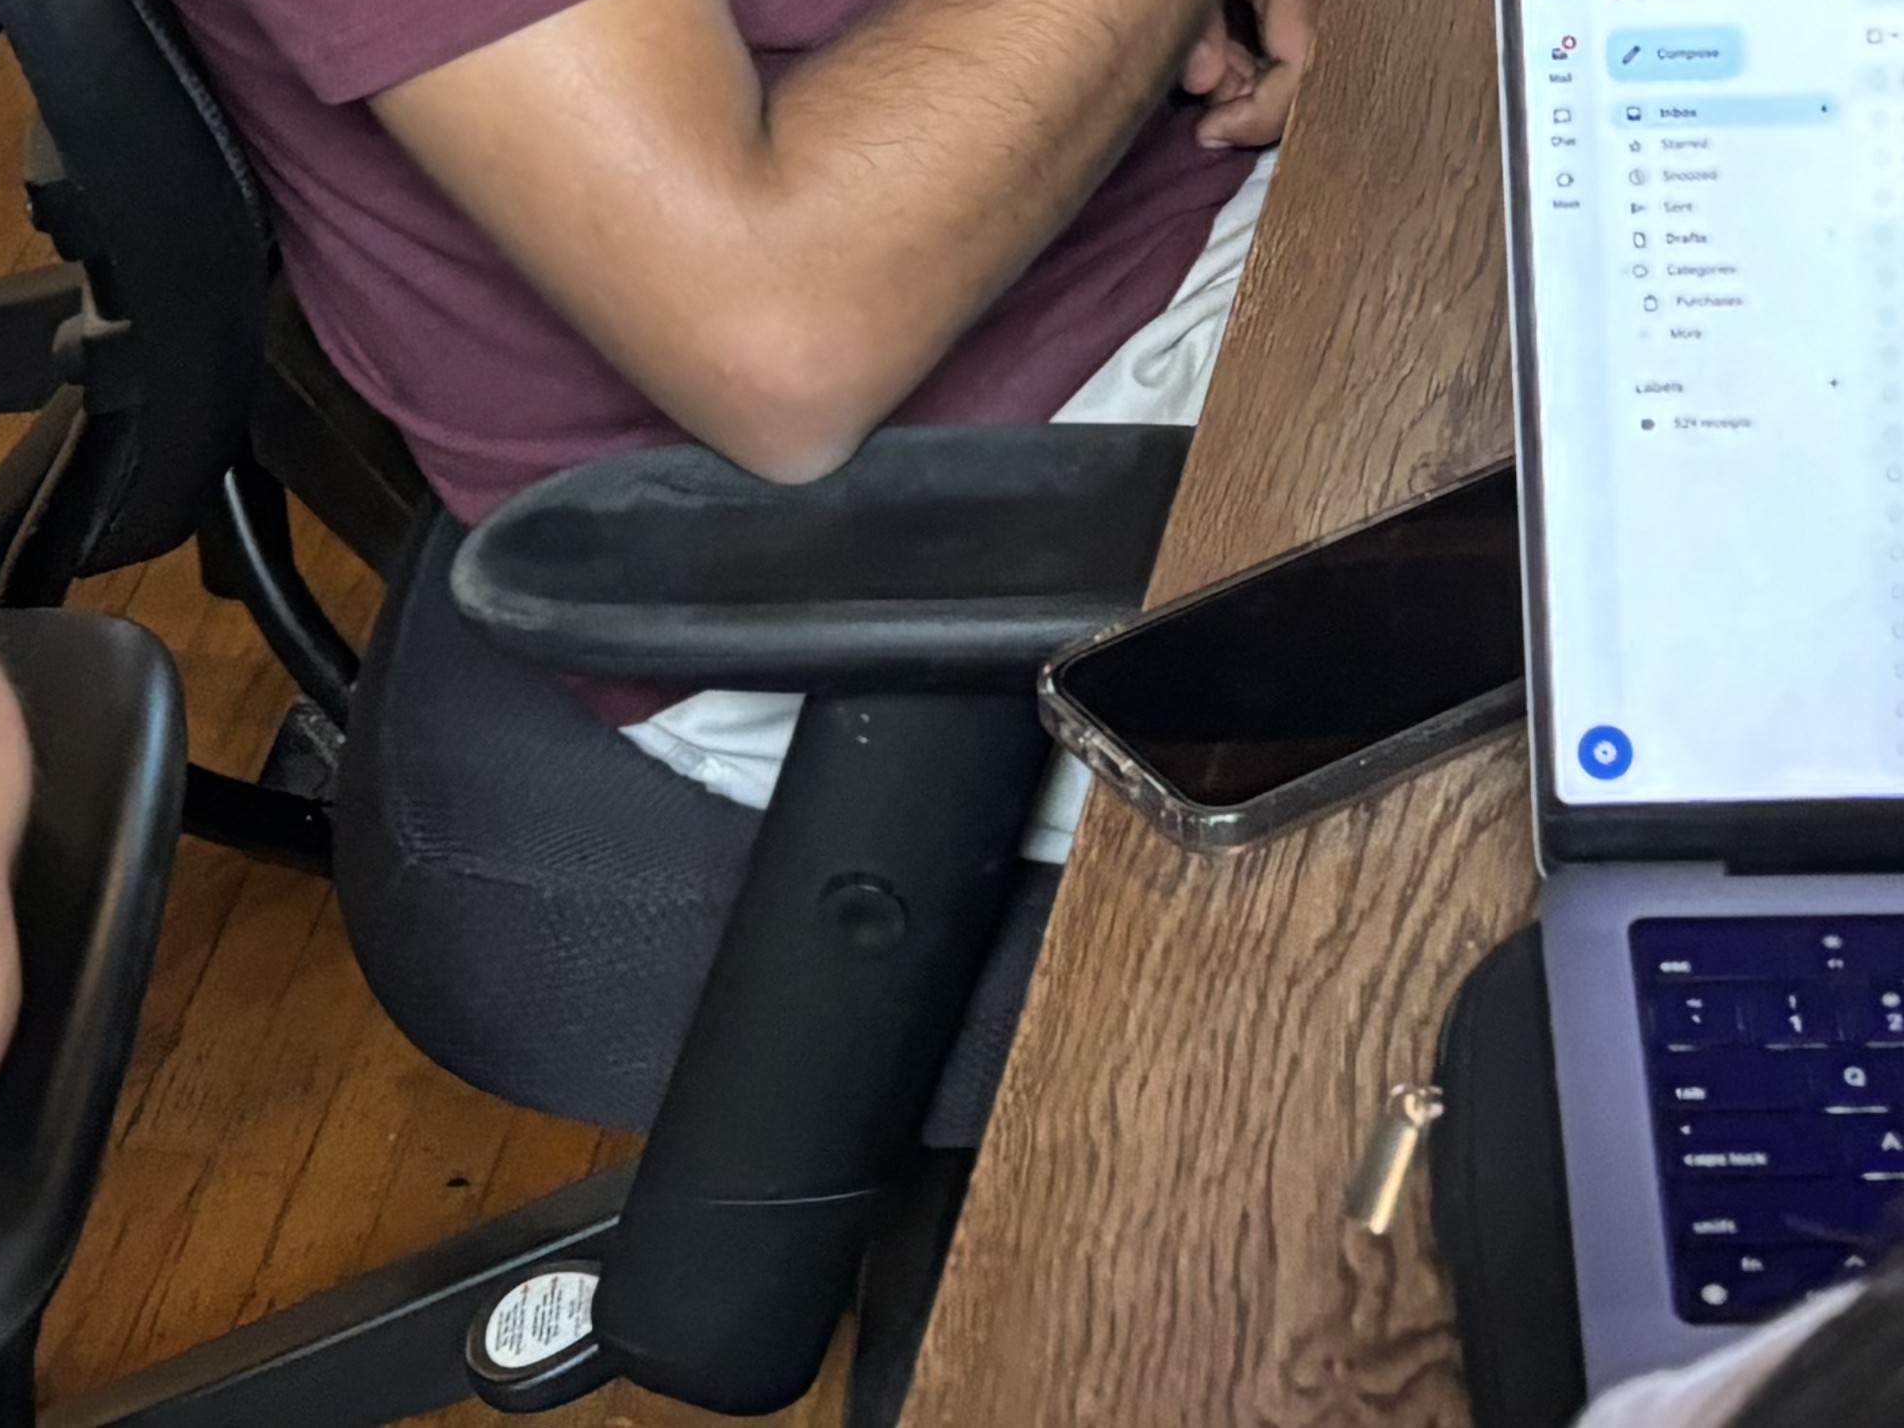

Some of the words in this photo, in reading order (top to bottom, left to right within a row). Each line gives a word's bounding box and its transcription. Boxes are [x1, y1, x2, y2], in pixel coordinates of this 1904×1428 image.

[1656, 47, 1721, 61] Compose
[1659, 106, 1698, 119] Inbox
[1665, 232, 1707, 245] Drafts
[1667, 263, 1736, 277] Categories
[1843, 1065, 1867, 1087] Q
[1881, 1131, 1904, 1152] A
